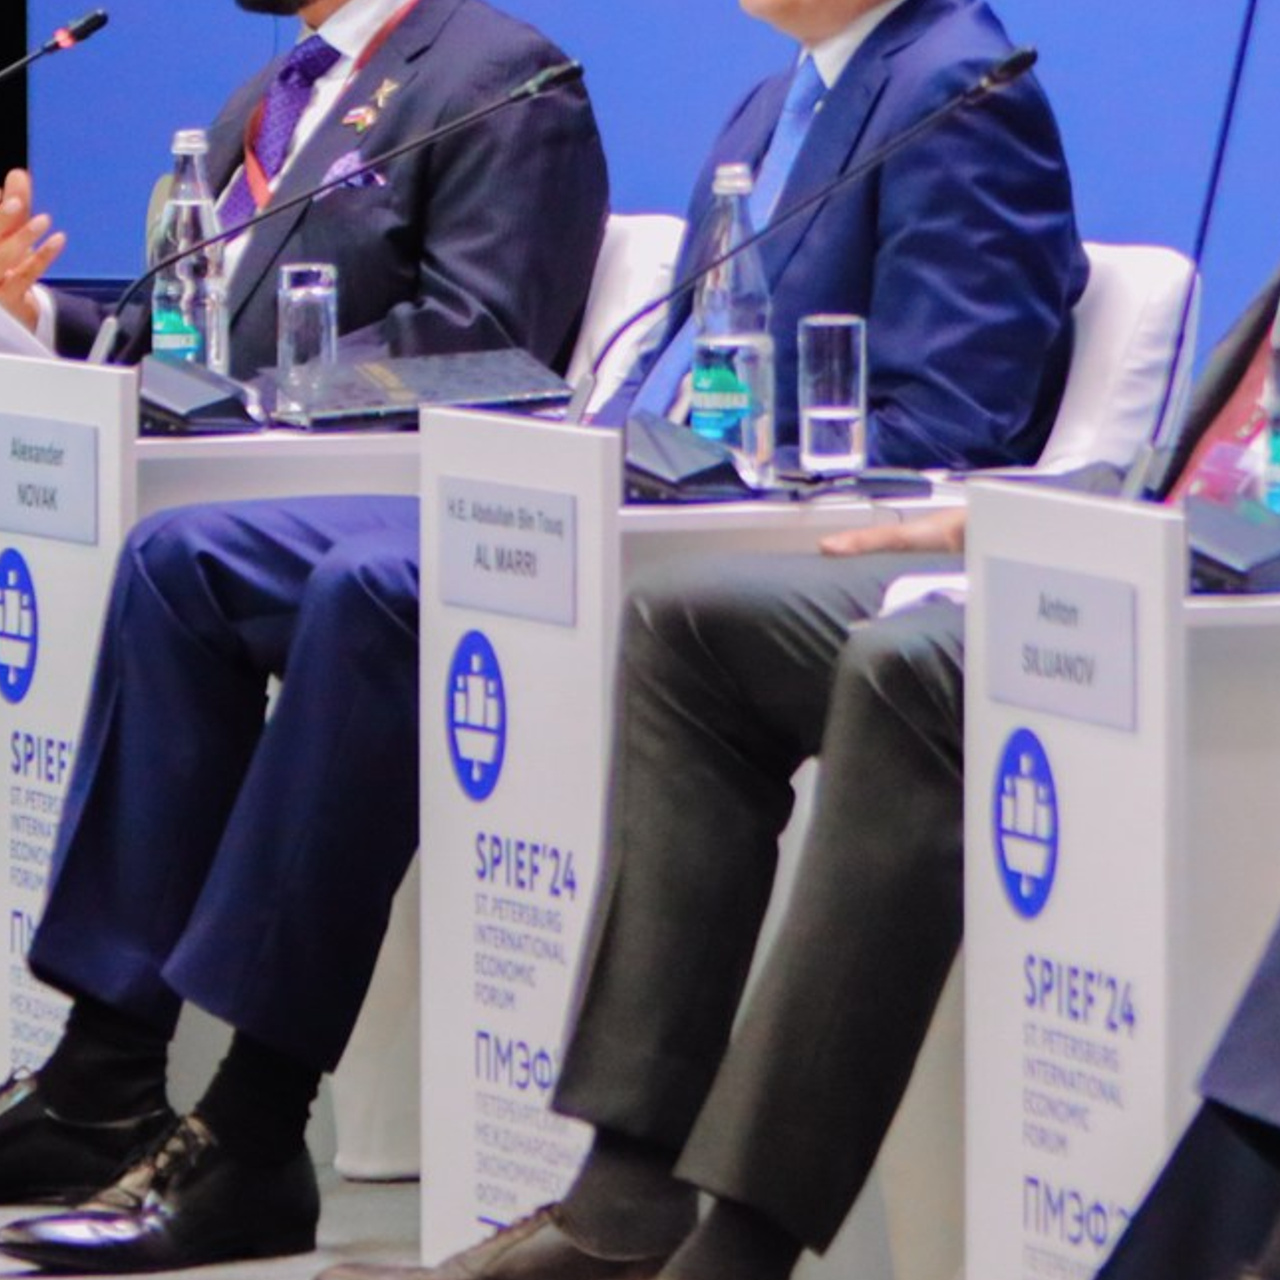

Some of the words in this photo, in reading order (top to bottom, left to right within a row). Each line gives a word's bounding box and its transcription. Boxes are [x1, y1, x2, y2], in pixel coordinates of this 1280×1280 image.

[17, 483, 58, 511] NOVAK
[474, 541, 491, 573] AL
[495, 544, 538, 580] MARRI
[476, 831, 577, 901] SPIEF'24
[1024, 953, 1136, 1040] SPIEF'24
